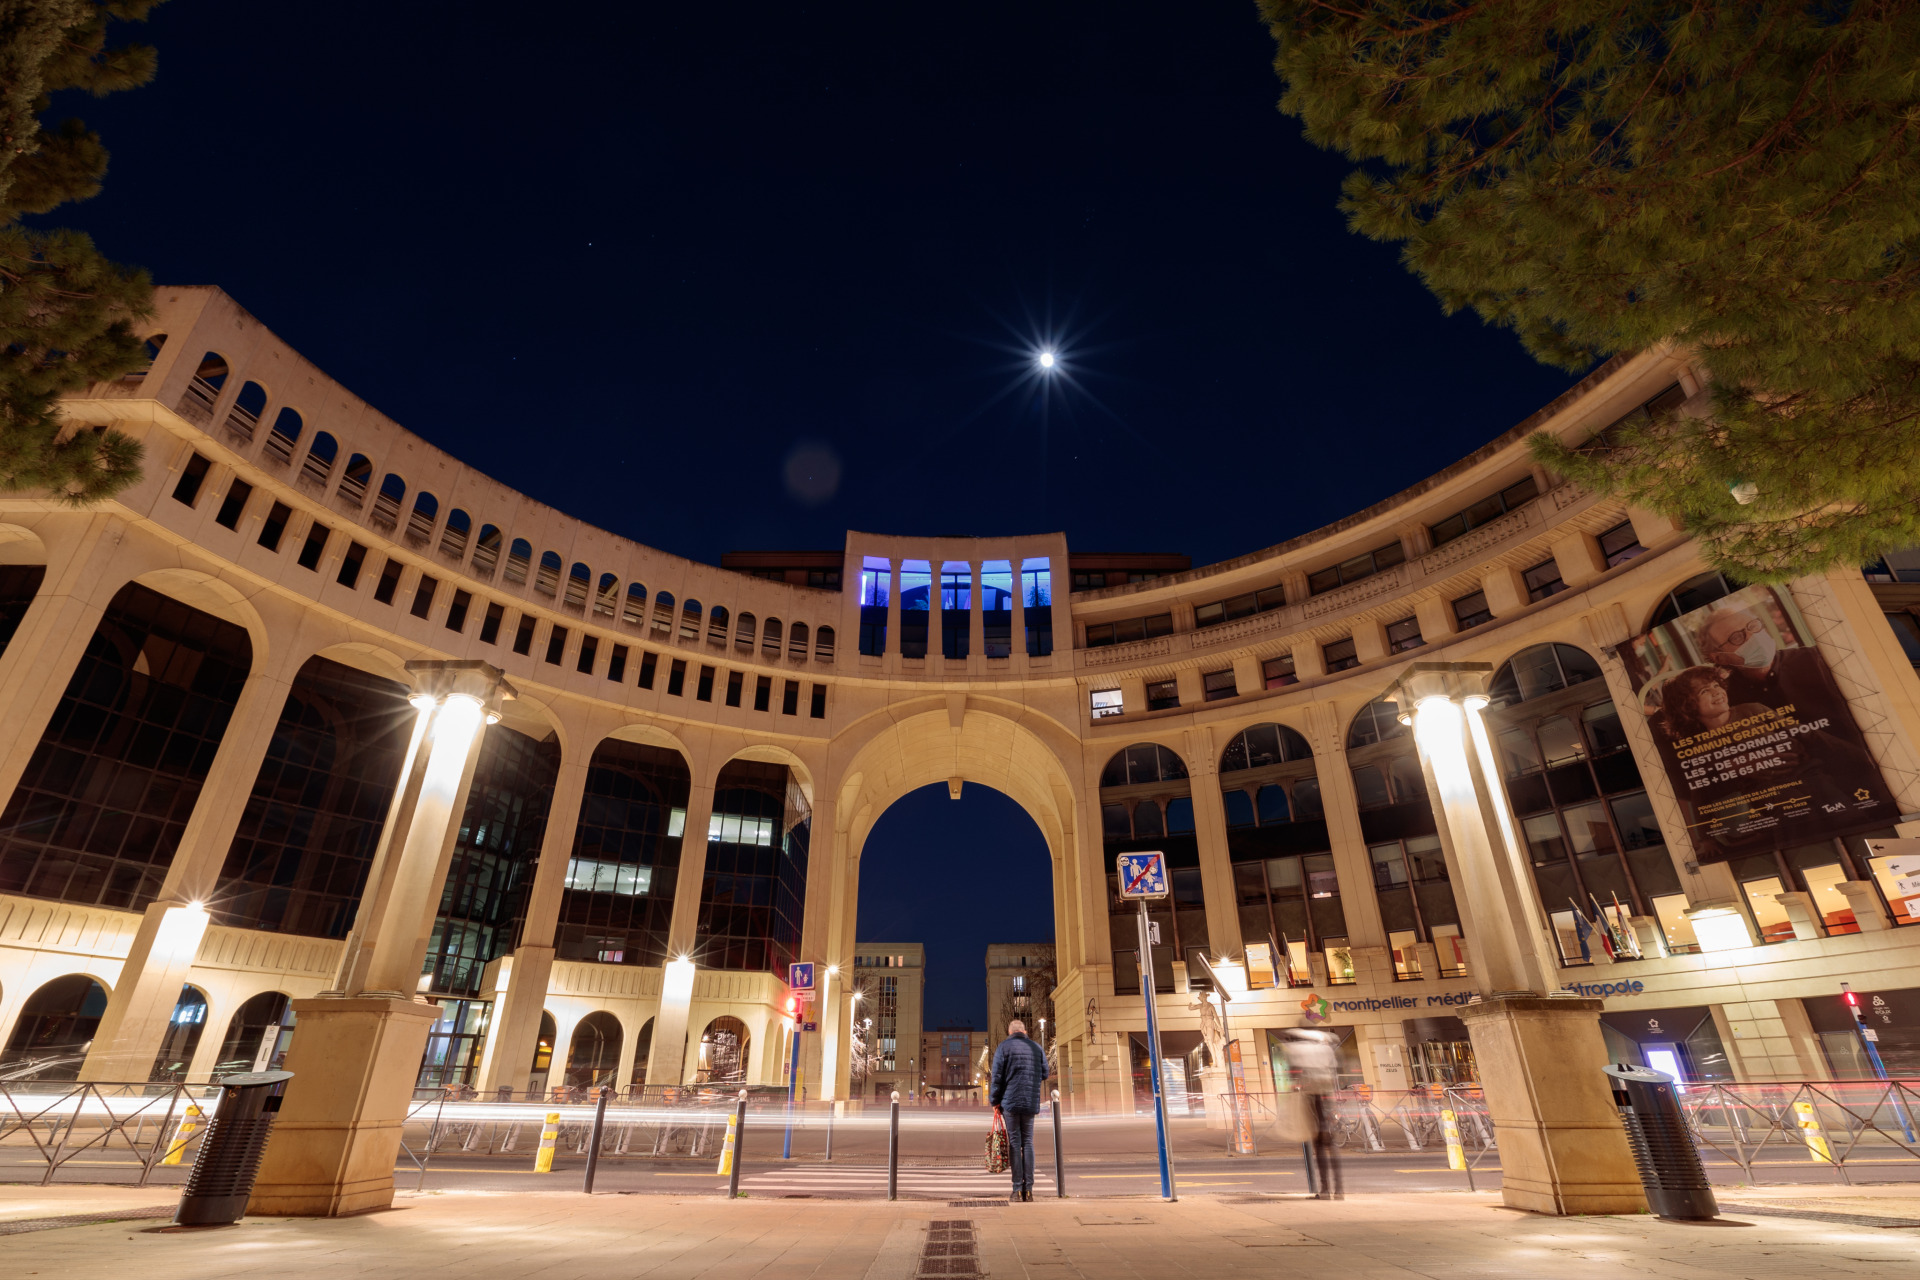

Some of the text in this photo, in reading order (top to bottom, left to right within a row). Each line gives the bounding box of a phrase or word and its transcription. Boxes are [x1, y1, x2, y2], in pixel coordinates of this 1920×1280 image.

[1672, 704, 1796, 749] LES TRANSPORTS EN
[1677, 716, 1799, 759] COMMUN GRATUITS,
[1681, 718, 1830, 769] C'EST DÉSORMAIS POUR
[1684, 767, 1706, 780] LES
[1714, 760, 1732, 771] DE
[1733, 755, 1747, 765] 18
[1749, 747, 1775, 761] ANS
[1776, 741, 1792, 753] ET
[1688, 778, 1710, 790] LES
[1720, 769, 1738, 781] DE
[1739, 765, 1754, 776] 65
[1756, 757, 1786, 771] ANS.
